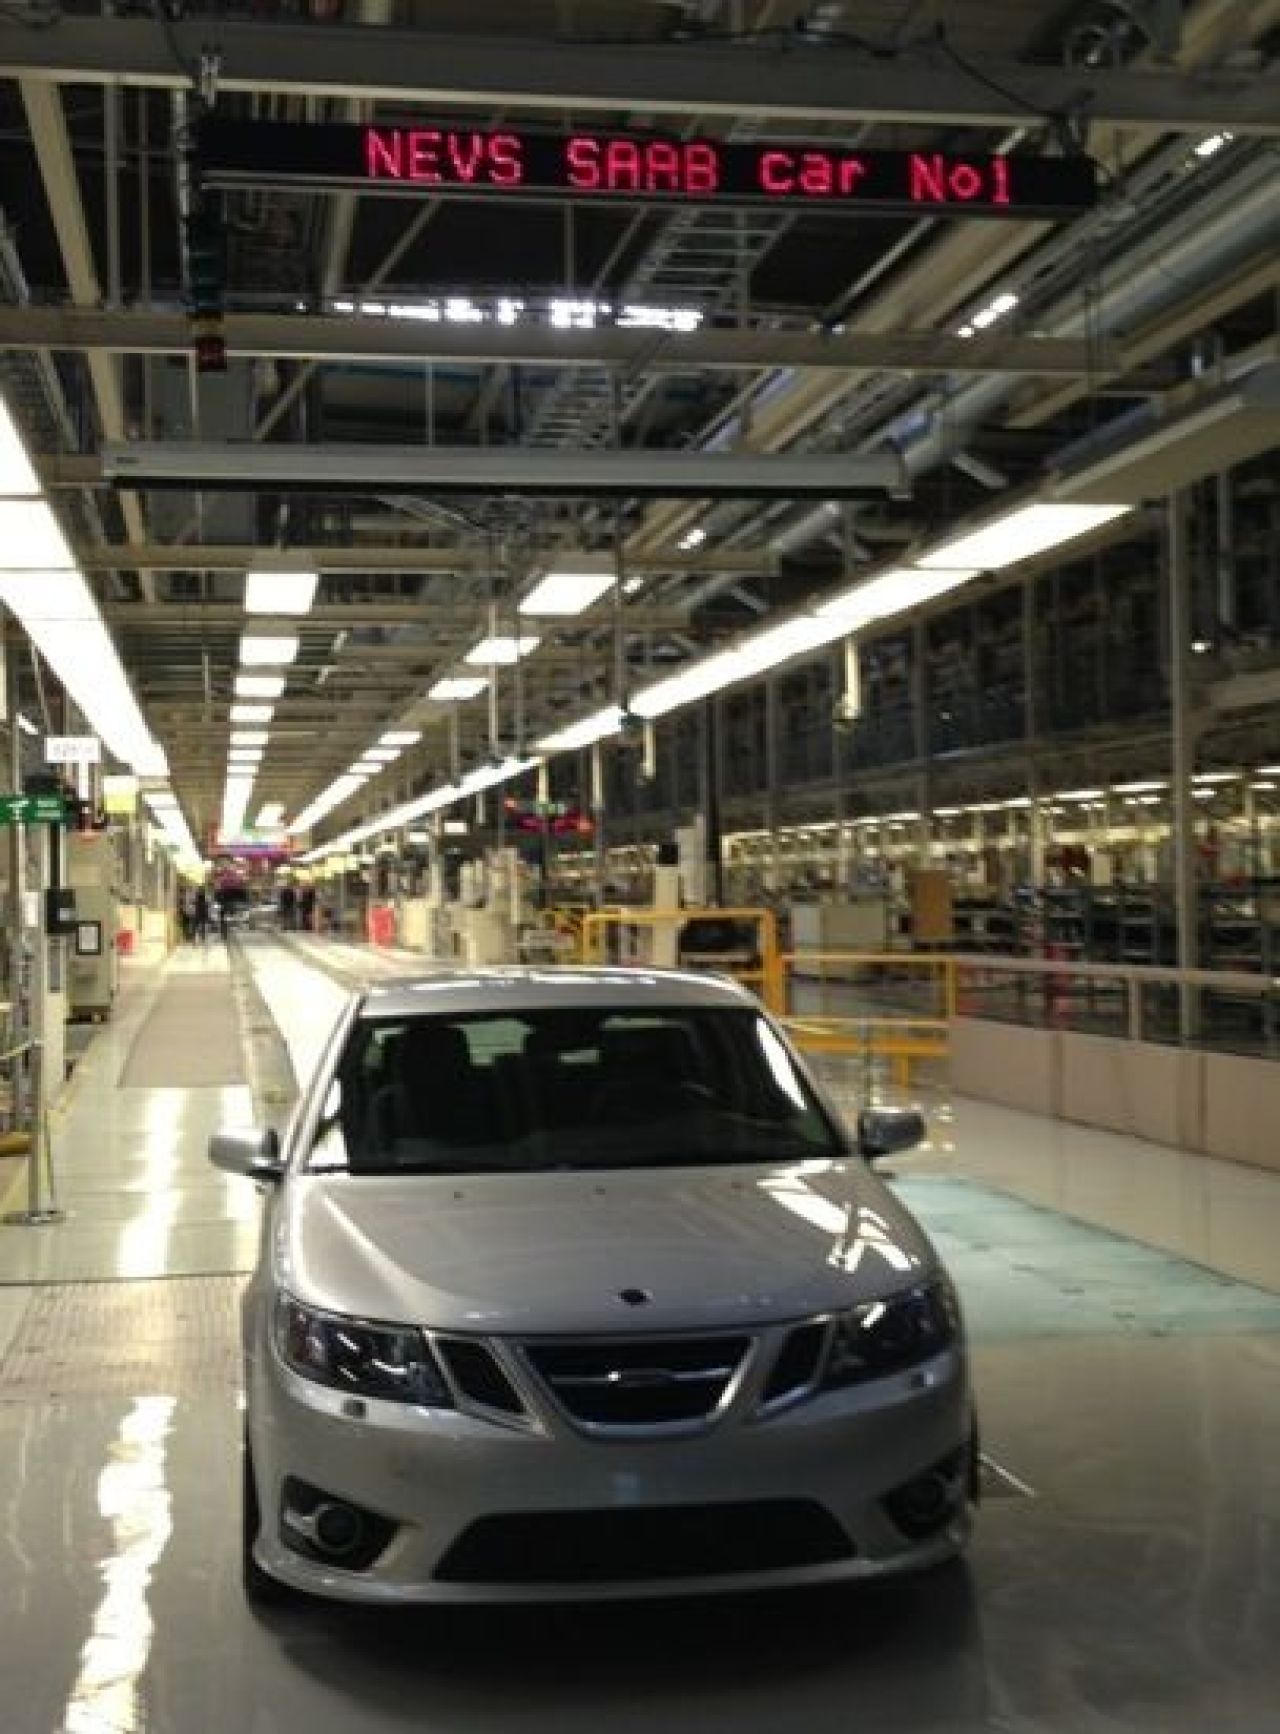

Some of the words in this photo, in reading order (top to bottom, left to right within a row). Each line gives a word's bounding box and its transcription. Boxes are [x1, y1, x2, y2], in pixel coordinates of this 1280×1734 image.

[367, 131, 520, 184] NEVS
[566, 138, 717, 190] SAAB
[759, 153, 862, 192] car
[911, 154, 1010, 203] No1
